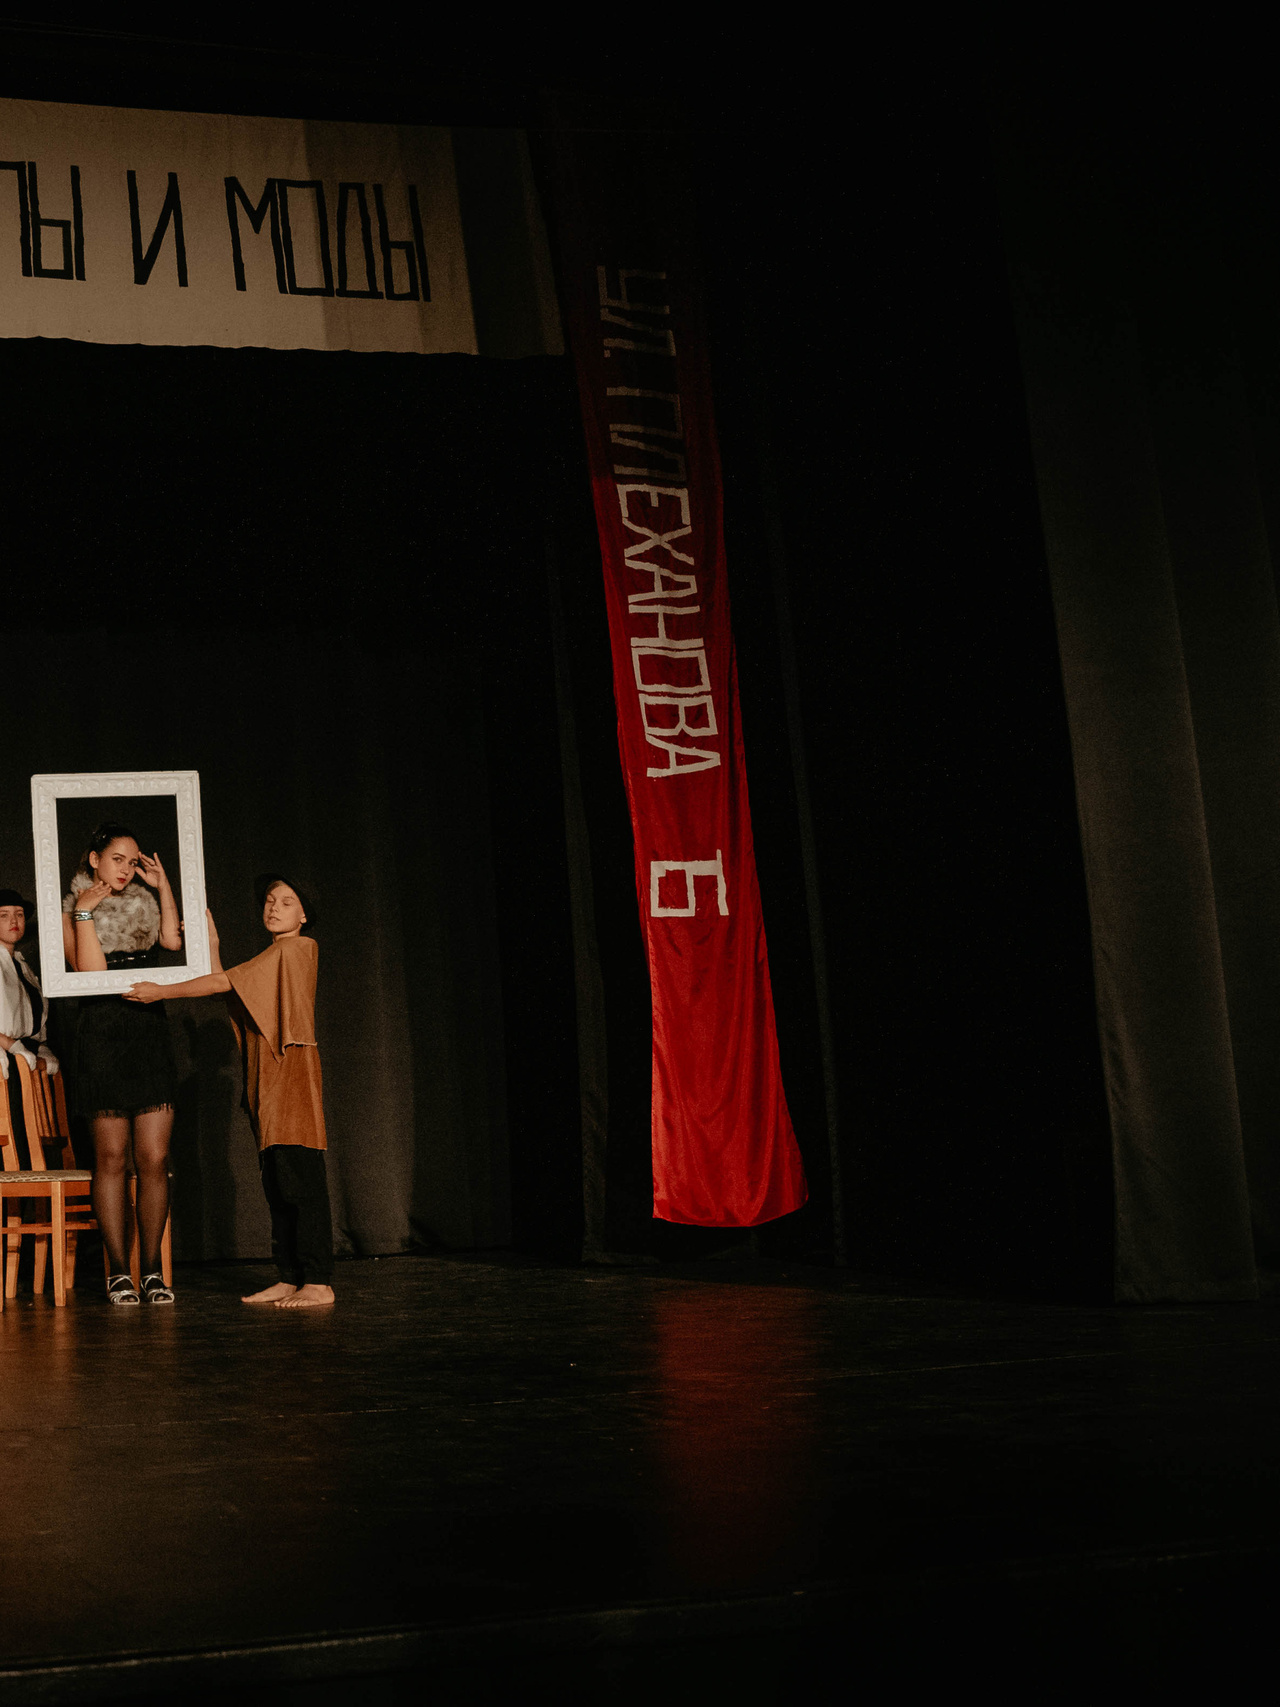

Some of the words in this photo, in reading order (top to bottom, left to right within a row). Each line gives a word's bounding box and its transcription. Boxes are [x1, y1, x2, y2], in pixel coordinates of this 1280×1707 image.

[126, 169, 188, 288] И
[224, 175, 431, 302] МОДЫ
[596, 265, 678, 358] УЛ.
[606, 384, 722, 779] ПЛЕХАНОВА
